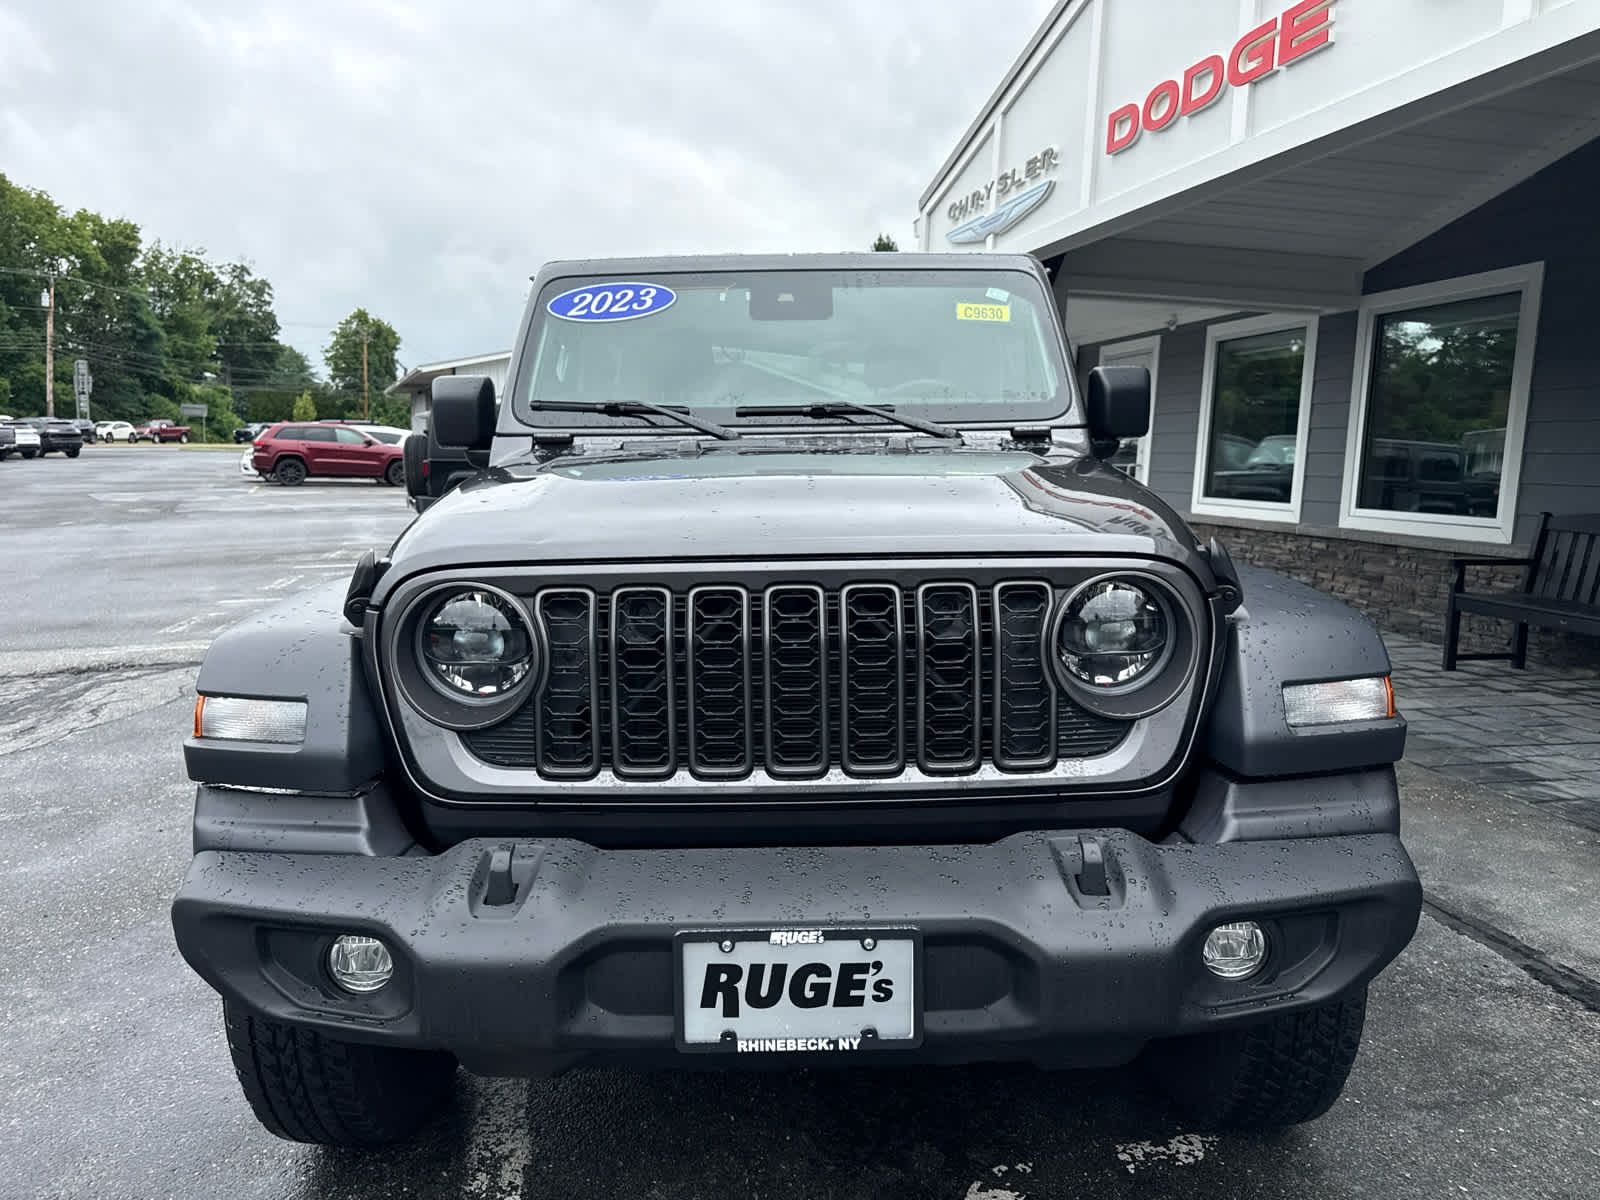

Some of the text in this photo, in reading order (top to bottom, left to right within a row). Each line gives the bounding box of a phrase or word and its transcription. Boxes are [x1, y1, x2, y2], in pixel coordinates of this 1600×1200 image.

[1106, 0, 1335, 155] DODGE
[948, 147, 1059, 220] CHRYSLER
[567, 288, 657, 316] 2023
[964, 306, 1003, 319] C9630
[700, 961, 893, 1018] RUGE's
[737, 1038, 861, 1052] RHINEBECK, NY
